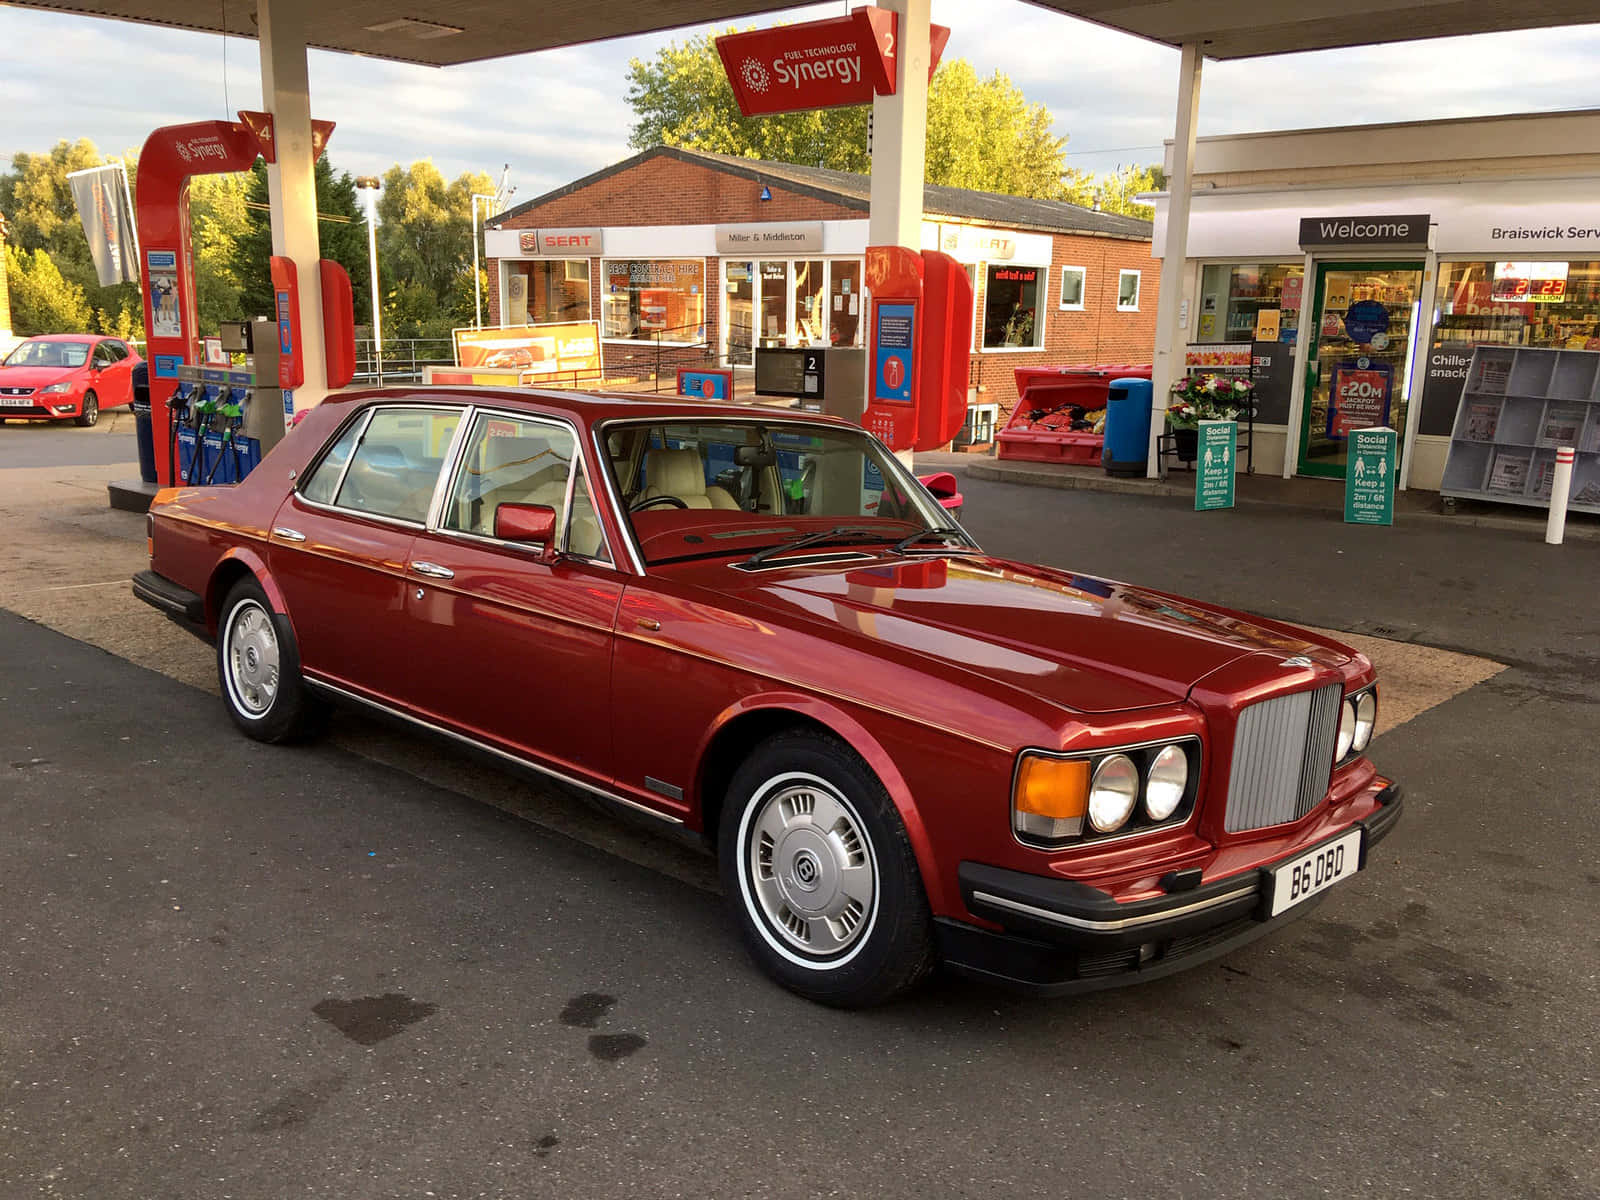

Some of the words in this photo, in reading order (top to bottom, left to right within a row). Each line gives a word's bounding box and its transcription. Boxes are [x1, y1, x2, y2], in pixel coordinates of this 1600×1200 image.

[884, 32, 894, 57] 2
[784, 51, 802, 60] FUEL
[804, 43, 857, 58] TECHNOLOGY
[773, 55, 861, 88] Synergy
[259, 126, 271, 140] 4
[187, 142, 228, 160] Synergy
[1319, 221, 1409, 238] Welcome
[1491, 227, 1564, 239] Braiswick
[545, 235, 592, 247] SEAT
[728, 233, 751, 242] Miller
[753, 233, 760, 241] &
[608, 264, 629, 274] SEAT
[630, 263, 675, 275] CONTRACT
[678, 264, 699, 275] HIRE
[1515, 279, 1528, 294] 2
[1541, 279, 1565, 294] 23
[1465, 301, 1521, 316] Deals
[808, 357, 816, 370] 2
[1430, 367, 1468, 378] snack
[1341, 381, 1382, 398] £20M
[1346, 397, 1375, 405] JACKPOT
[1206, 426, 1231, 435] Social
[1357, 434, 1388, 444] Social
[1205, 468, 1223, 476] Keep
[1203, 481, 1214, 489] 2m
[1219, 480, 1228, 488] 6ft
[1354, 478, 1378, 488] Keep
[1353, 493, 1366, 501] 2m
[1373, 493, 1385, 502] 6ft
[1352, 502, 1385, 510] distance
[1290, 860, 1312, 901] B6
[1315, 844, 1344, 887] DBD
